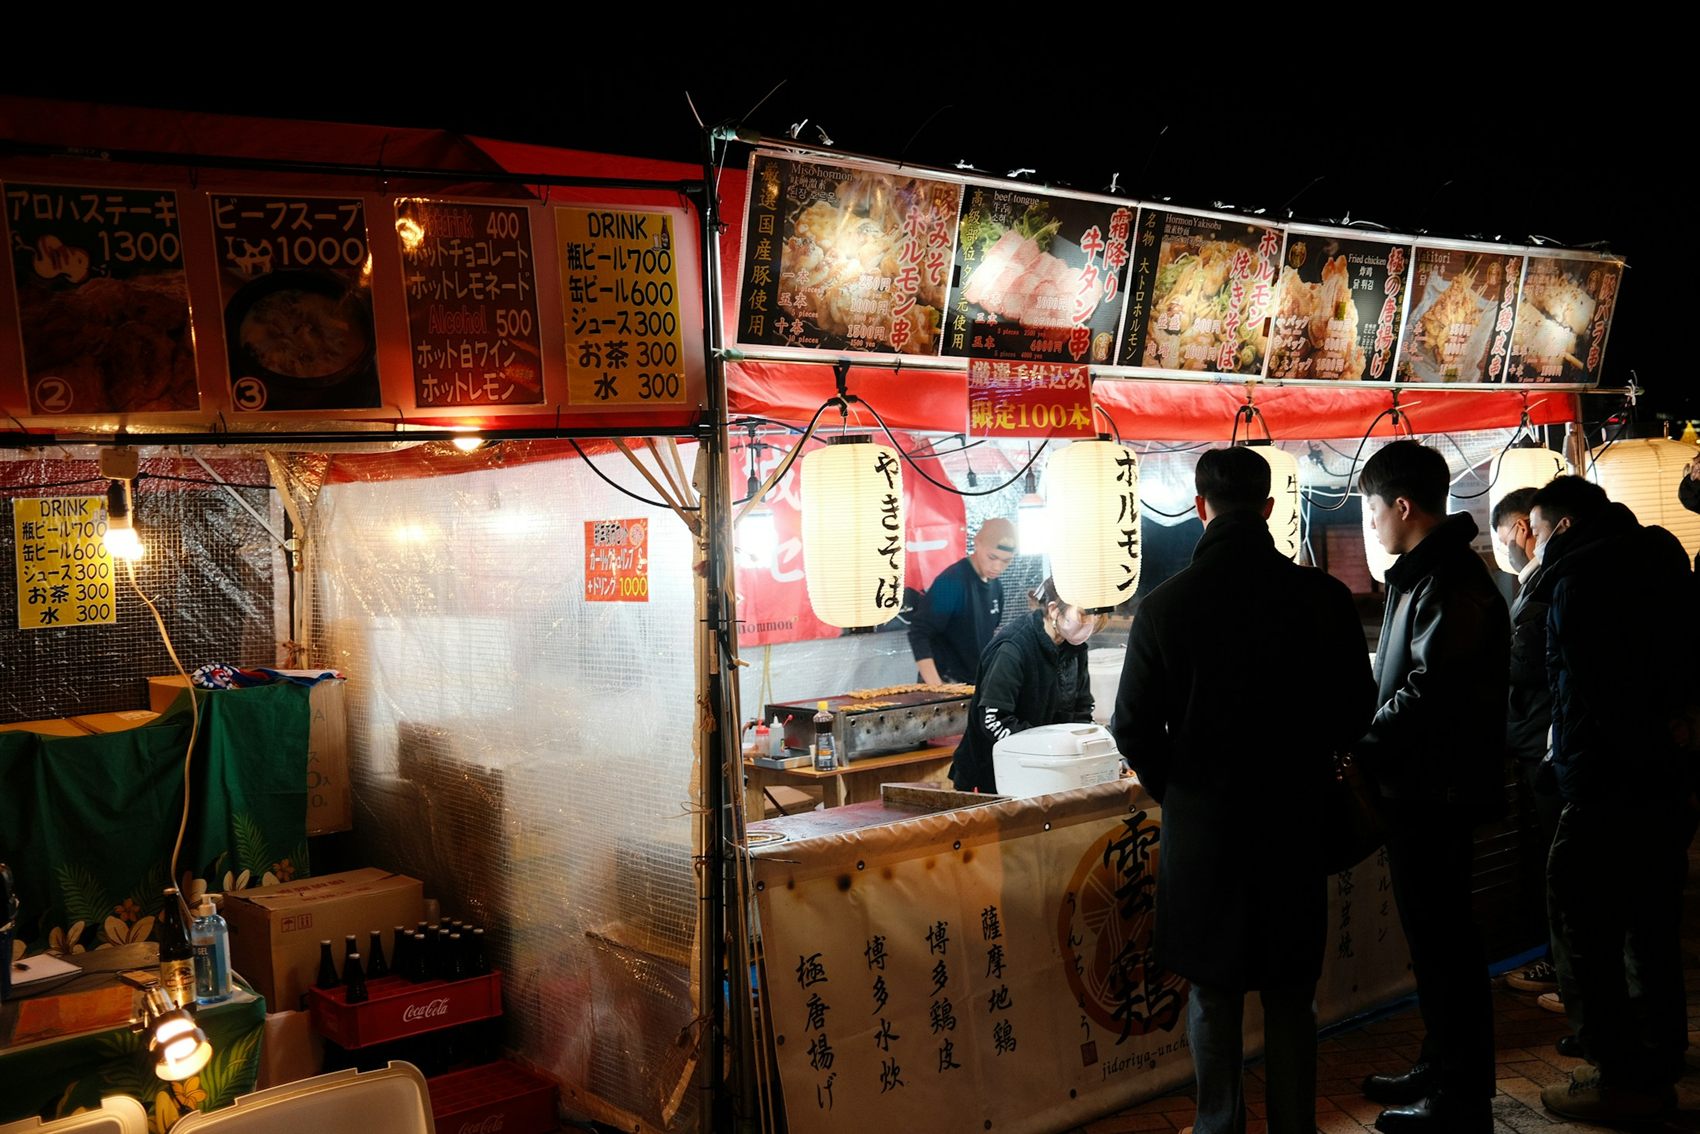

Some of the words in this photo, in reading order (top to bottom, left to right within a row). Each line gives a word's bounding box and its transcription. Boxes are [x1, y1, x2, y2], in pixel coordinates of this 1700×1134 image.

[791, 162, 814, 176] Miso
[816, 166, 853, 182] hormon
[7, 190, 177, 226] アロハステーキ
[994, 190, 1012, 202] beef
[1013, 194, 1040, 206] tongue
[214, 198, 363, 231] ビーフスープ
[486, 212, 519, 239] 400
[587, 211, 648, 239] DRINK
[1142, 211, 1157, 247] 名物
[99, 230, 180, 262] 1300
[277, 236, 369, 266] 1000
[748, 162, 782, 337] 厳選国産豚使用
[1103, 207, 1134, 304] 霜降り
[1348, 253, 1363, 265] Fried
[411, 270, 530, 300] ホットレモネード
[889, 207, 926, 352] ホルモン串
[1068, 225, 1105, 361] 牛タン串
[1248, 229, 1278, 329] ホルモン
[428, 304, 488, 334] Alcohol
[496, 309, 532, 336] 500
[1126, 257, 1149, 360] 大トロホルモン
[1217, 250, 1250, 370] 焼きそば
[1370, 246, 1405, 379] 極の唐揚げ
[417, 339, 516, 370] ホット白ワイン
[578, 340, 629, 369] お茶
[636, 341, 677, 368] 300
[422, 372, 516, 402] ホットレモン
[594, 372, 618, 400] 水
[638, 373, 679, 399] 300
[971, 400, 1091, 430] 限定100本
[40, 499, 88, 517] DRINK
[1114, 450, 1139, 592] ホルモン
[28, 584, 69, 604] お茶
[75, 583, 109, 601] 300
[620, 576, 648, 596] 1000
[40, 606, 59, 624] 水
[76, 603, 110, 622] 300
[981, 905, 1017, 1057] 薩摩地鶏
[925, 921, 961, 1074] 博多鶏皮
[864, 935, 905, 1094] 博多水炊
[795, 952, 837, 1112] 極唐揚げ
